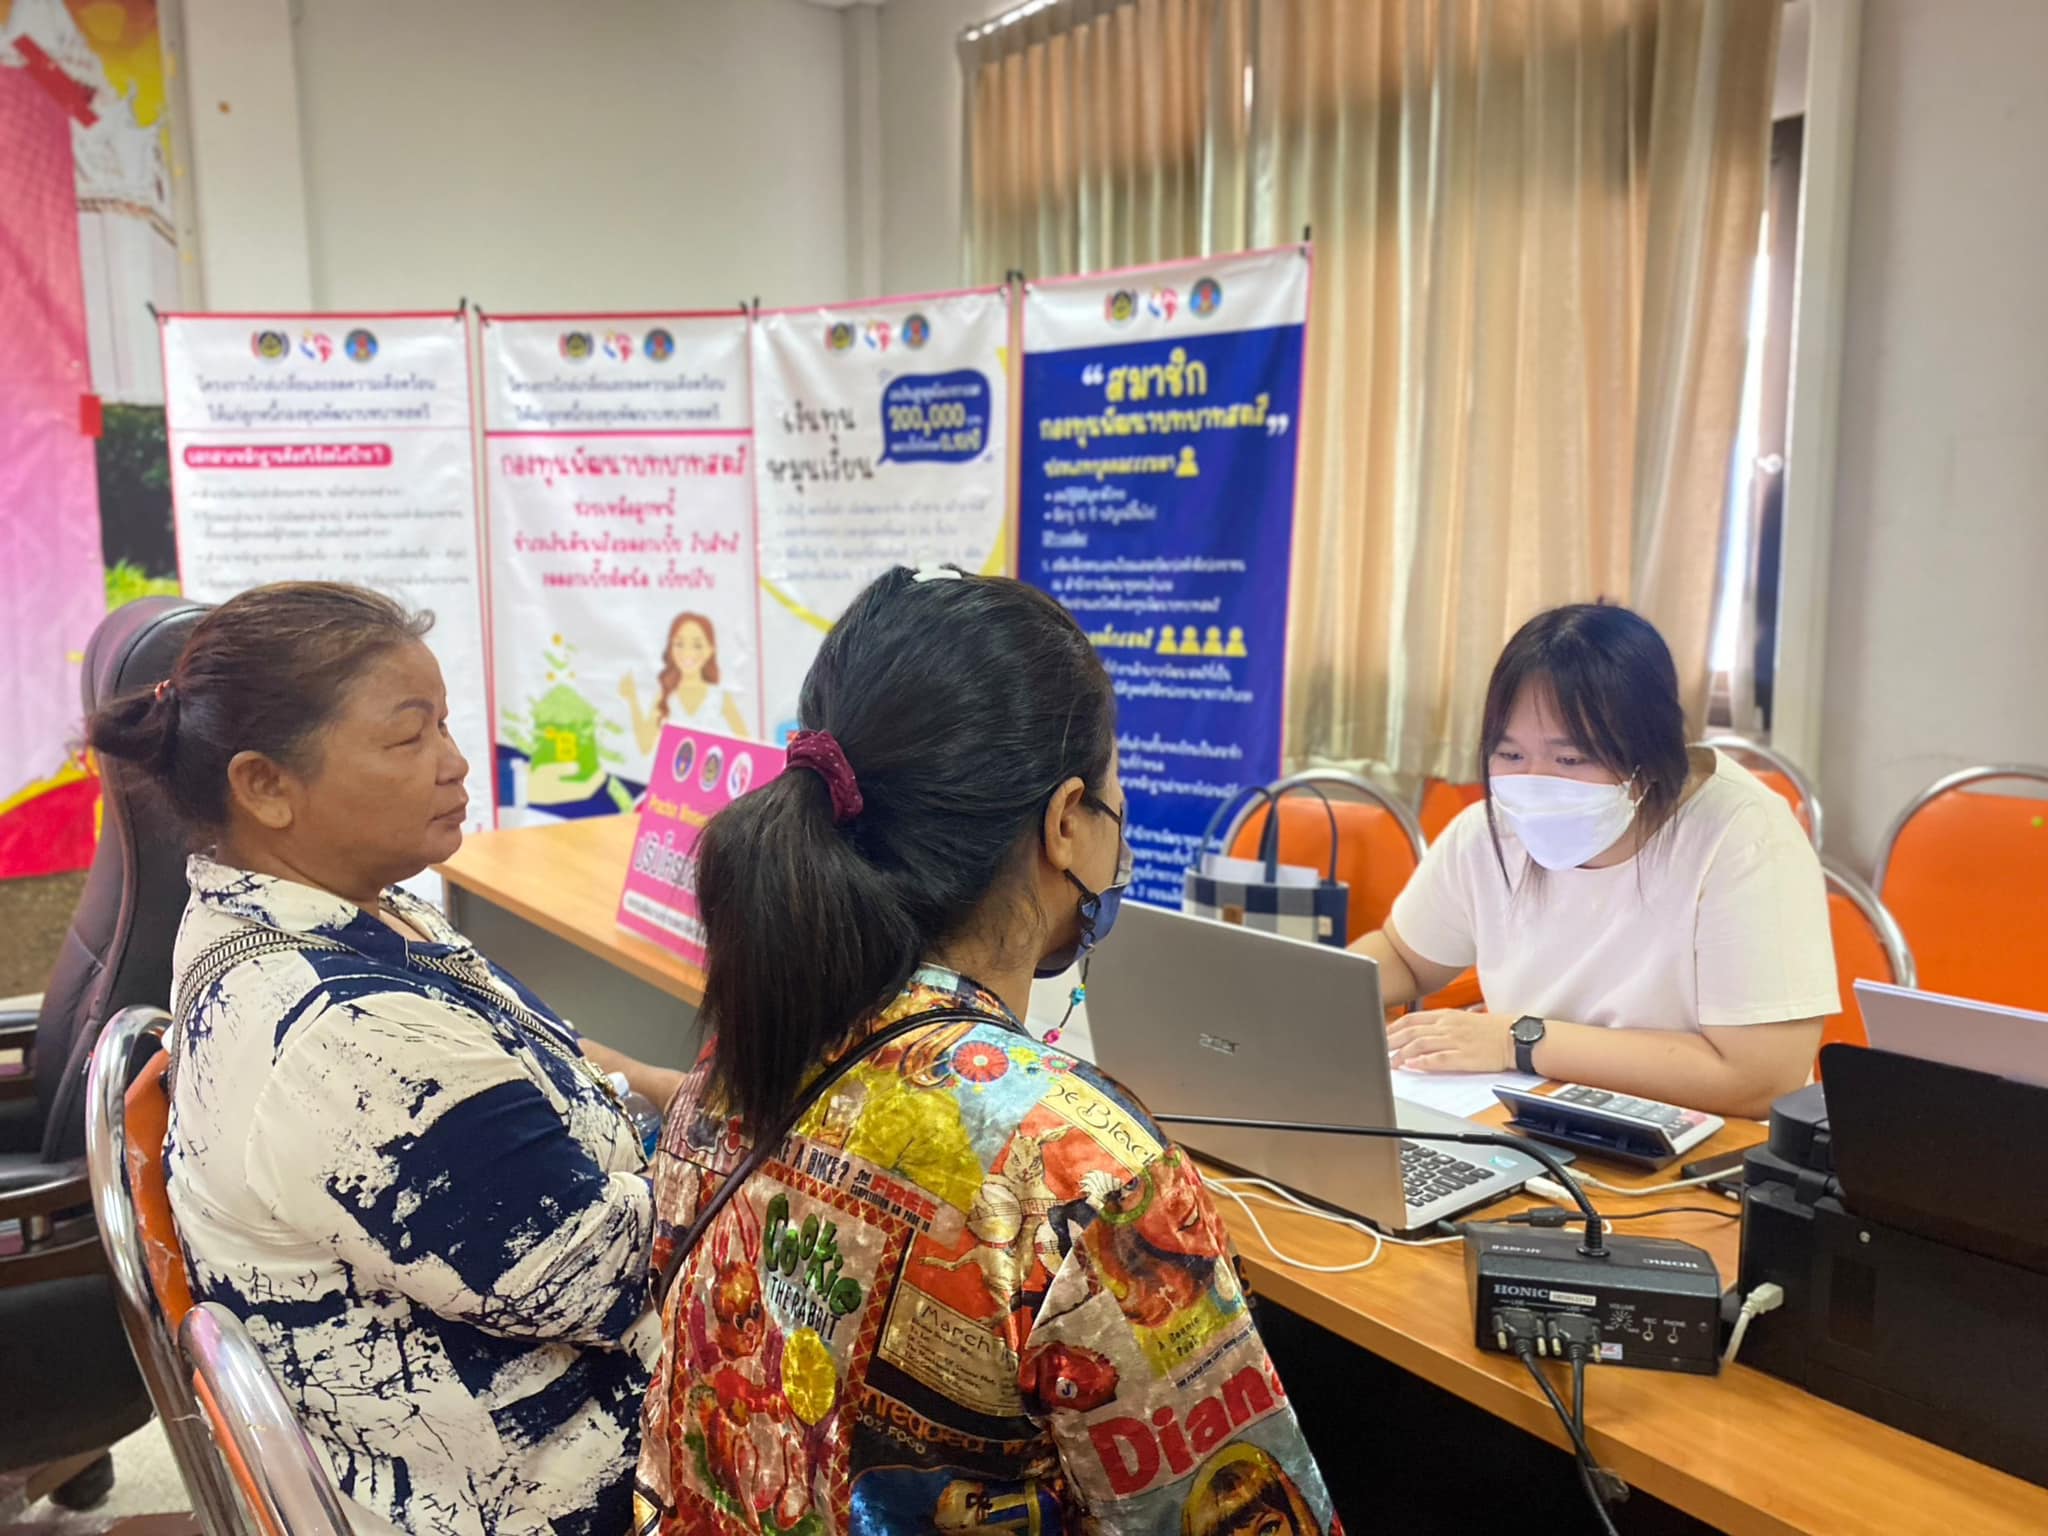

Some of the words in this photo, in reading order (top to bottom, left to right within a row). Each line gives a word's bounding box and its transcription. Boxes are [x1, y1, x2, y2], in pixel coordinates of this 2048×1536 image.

[806, 1147, 850, 1188] BIKE?
[870, 1173, 939, 1222] FREE
[770, 1276, 791, 1311] THE
[790, 1290, 841, 1341] RABBIT
[921, 1305, 991, 1354] March
